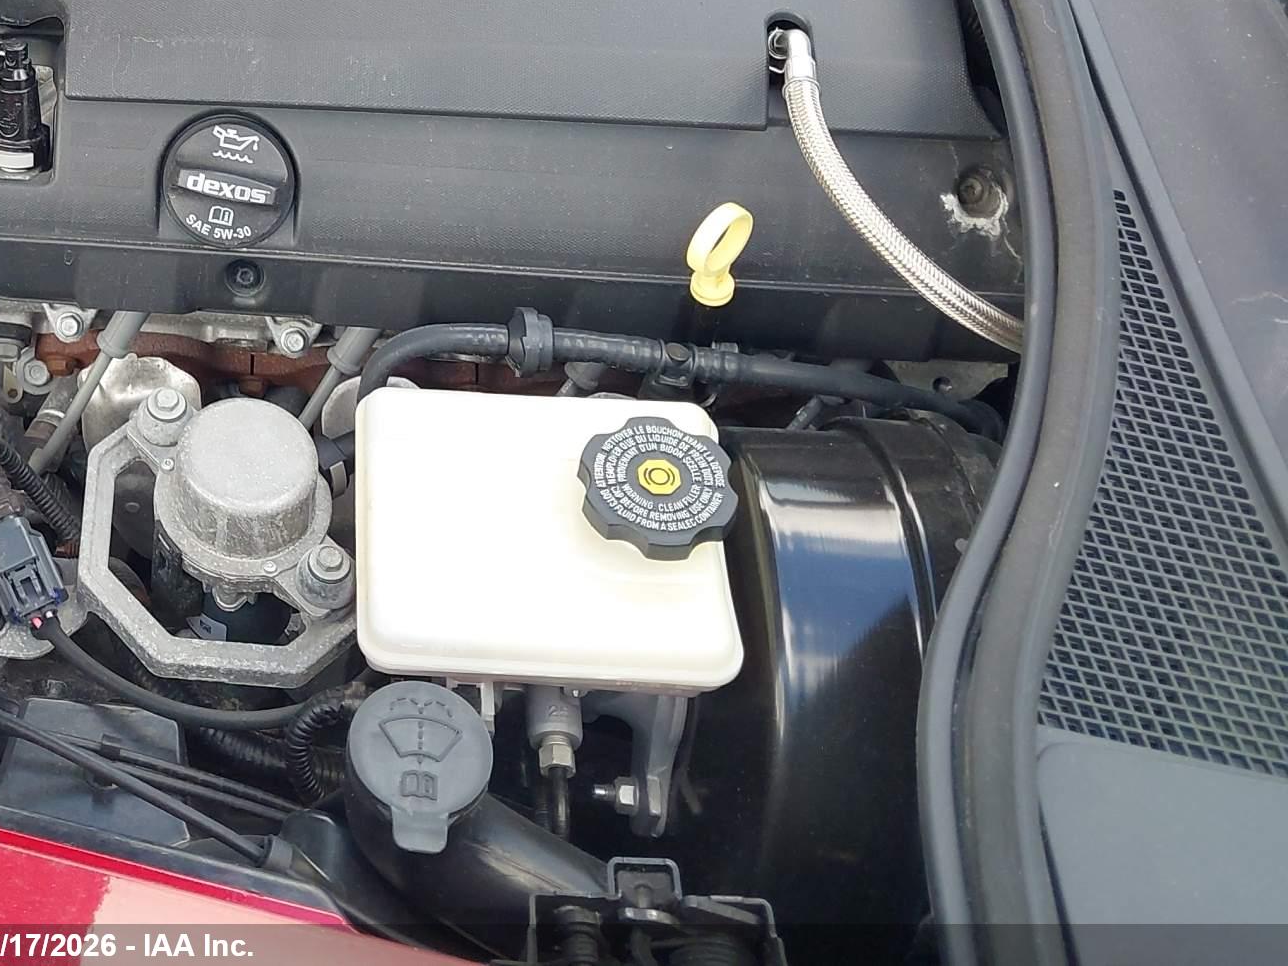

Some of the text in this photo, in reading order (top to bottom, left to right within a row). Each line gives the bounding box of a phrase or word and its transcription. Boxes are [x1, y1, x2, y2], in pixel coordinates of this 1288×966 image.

[186, 173, 267, 204] dexos
[185, 214, 252, 240] SAE 5W-30
[619, 437, 636, 450] QUE
[635, 434, 647, 444] DU
[647, 434, 679, 446] LIQUIDE
[678, 441, 691, 452] DE
[634, 425, 645, 435] LE
[645, 425, 684, 439] BOUCHON
[683, 435, 708, 454] AVANT
[704, 451, 715, 463] LA
[660, 443, 685, 459] BIDON
[610, 485, 625, 499] CAP
[619, 496, 649, 517] BEFORE
[689, 500, 705, 515] USE
[699, 486, 713, 505] ONLY
[614, 504, 637, 522] FLUID
[635, 516, 660, 531] FROM
[660, 522, 667, 531] A
[695, 492, 725, 524] CONTAINER
[658, 499, 685, 513] CLEAN
[682, 484, 702, 507] FILLER
